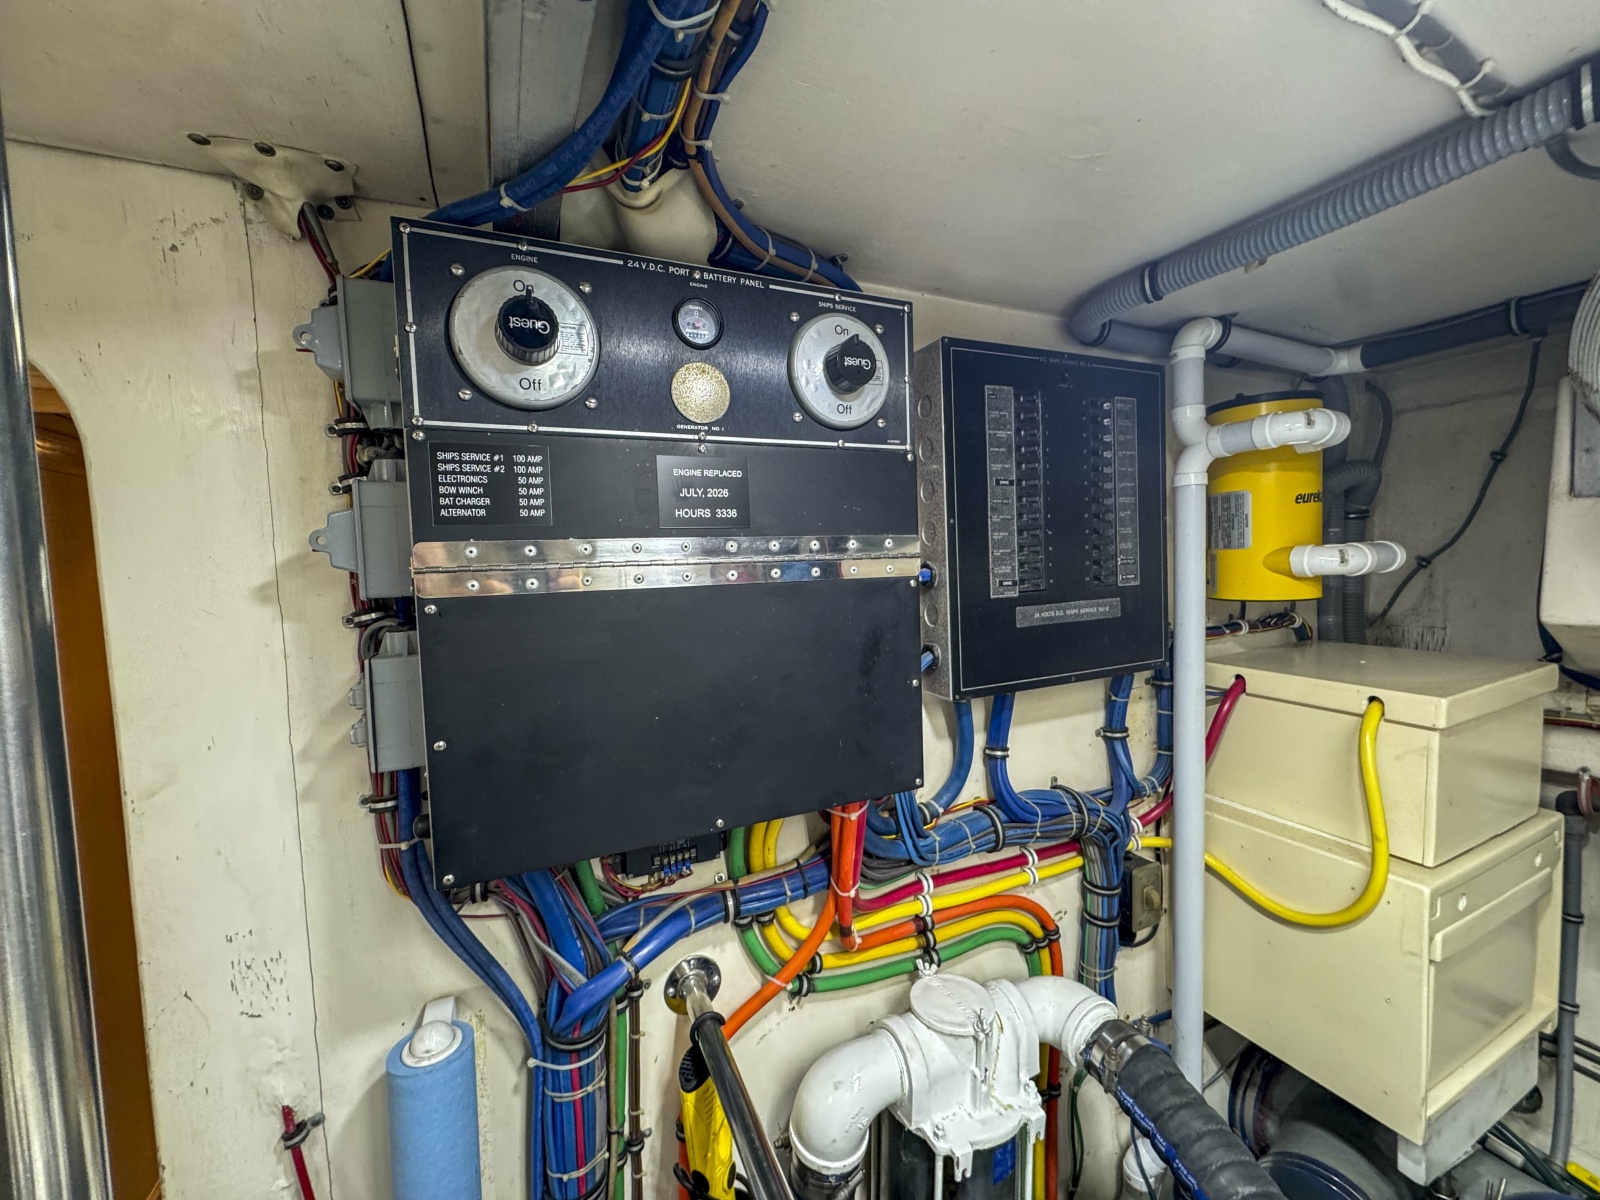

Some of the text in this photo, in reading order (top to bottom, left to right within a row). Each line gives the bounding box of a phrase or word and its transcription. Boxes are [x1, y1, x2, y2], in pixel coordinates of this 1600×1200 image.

[510, 253, 539, 263] ENGINE
[668, 266, 690, 277] PORT
[703, 272, 737, 284] BATTERY
[740, 278, 765, 289] PANEL
[513, 279, 535, 294] On
[689, 281, 708, 289] ENGINE
[818, 301, 857, 313] SHIPS SERVICE
[508, 316, 551, 335] Guest
[834, 324, 849, 336] On
[843, 356, 871, 370] Guest
[519, 377, 542, 391] Off
[836, 403, 852, 415] Off
[436, 452, 504, 462] SHIPS SERVICE #1
[512, 455, 543, 463] 100 AMP
[437, 463, 505, 473] SHIPS SERVICE #2
[513, 466, 543, 474] 100 AMP
[673, 468, 742, 478] ENGINE REPLACED
[438, 474, 488, 484] ELECTRONICS
[518, 477, 544, 485] 50 AMP
[438, 486, 483, 494] BOW WINCH
[518, 487, 527, 495] 50
[679, 488, 729, 498] JULY, 2026
[439, 497, 491, 506] BAT CHARGER
[519, 498, 545, 506] 50 AMP
[440, 508, 486, 517] ALTERNATOR
[520, 509, 545, 517] 50 AMP
[675, 508, 737, 518] HOURS 3336
